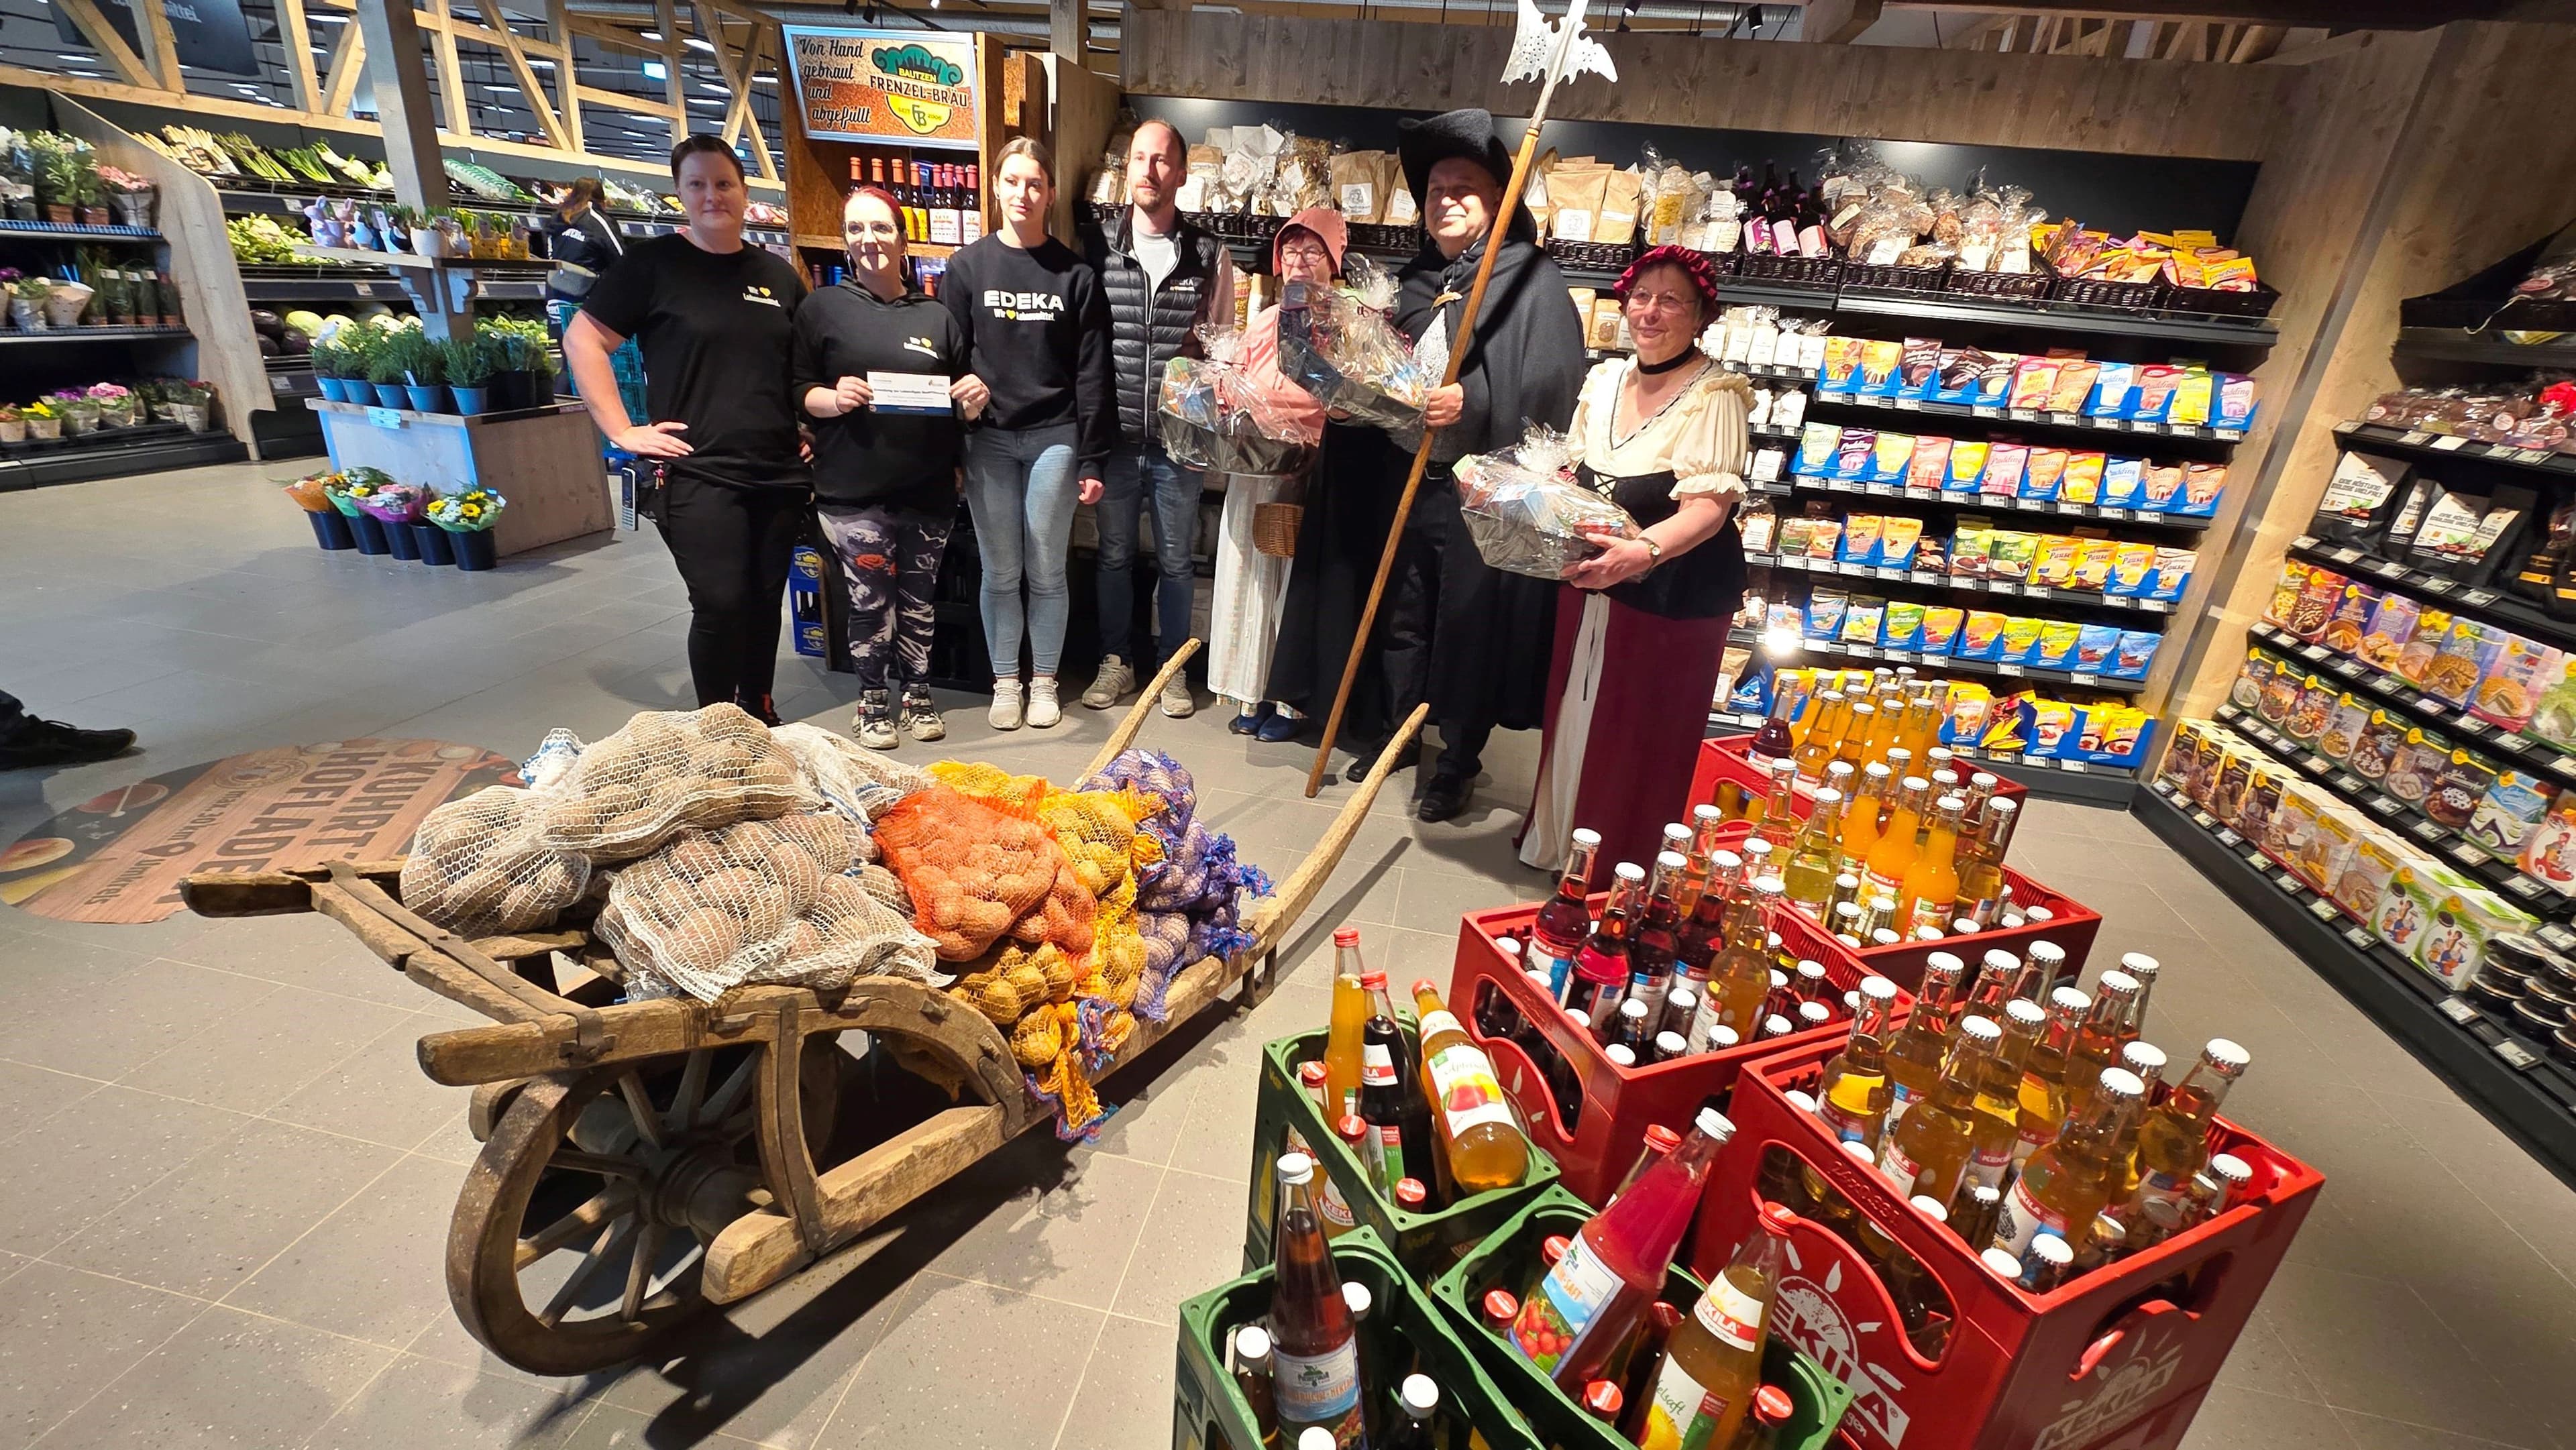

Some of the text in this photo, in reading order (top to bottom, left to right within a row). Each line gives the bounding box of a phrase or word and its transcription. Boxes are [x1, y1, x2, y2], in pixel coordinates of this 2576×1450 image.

[800, 38, 864, 58] Von Hand
[804, 61, 855, 84] gebraut
[898, 66, 938, 83] BAUTZEN
[808, 85, 833, 101] und
[869, 74, 968, 107] FRENZEL-BRÄU
[812, 104, 871, 130] abgefüllt
[983, 289, 1065, 312] EDEKA
[2050, 551, 2072, 560] Pause
[2086, 553, 2108, 562] Pause
[2123, 555, 2145, 564] Pause
[2162, 561, 2185, 571] Pause
[154, 750, 386, 905] HOFLADE
[1324, 1201, 1354, 1219] KEKI
[1768, 1299, 1890, 1436] EKILA
